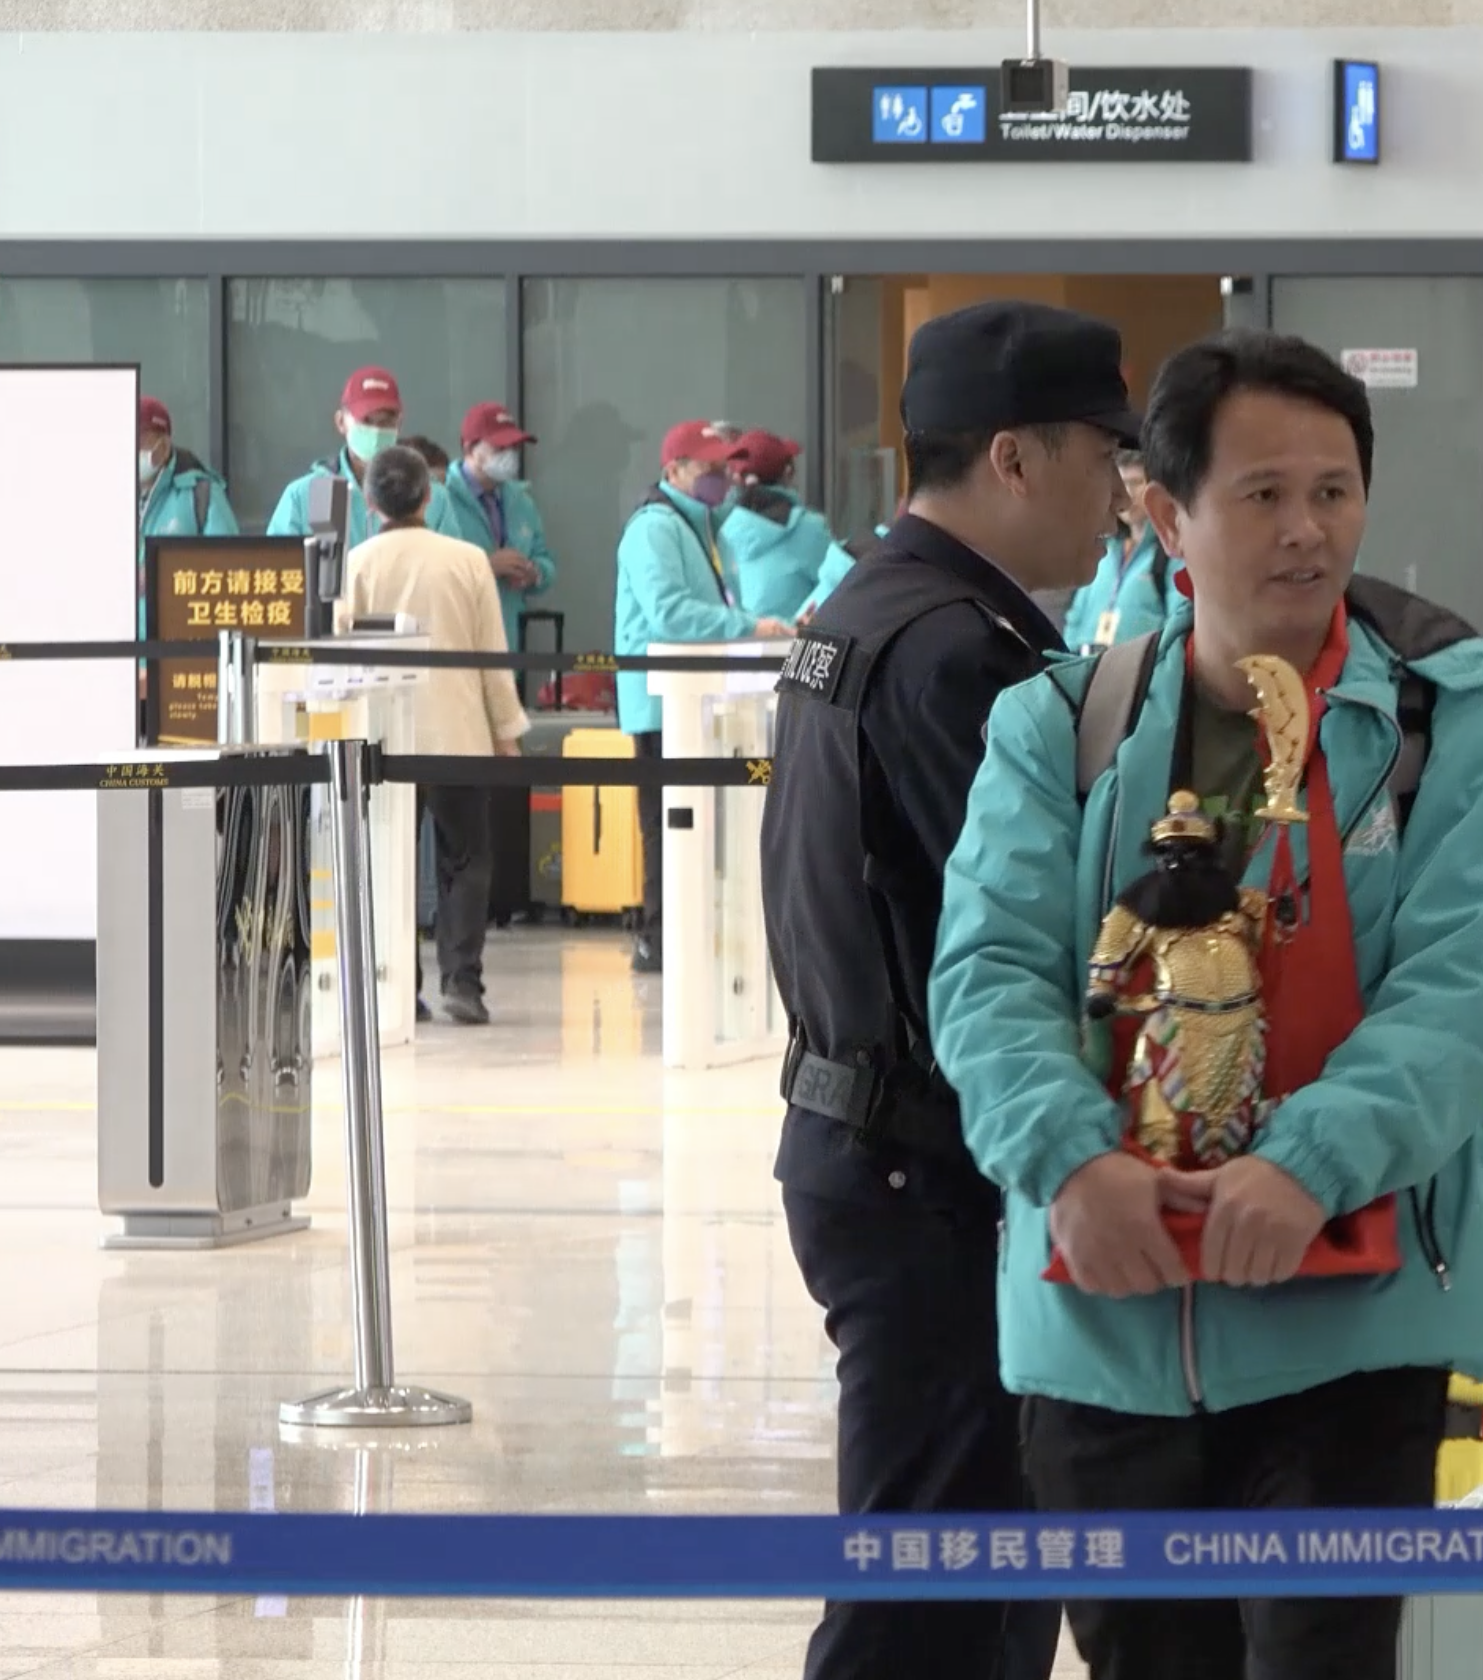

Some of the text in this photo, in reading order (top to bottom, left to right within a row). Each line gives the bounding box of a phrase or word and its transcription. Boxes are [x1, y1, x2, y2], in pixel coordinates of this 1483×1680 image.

[1000, 89, 1191, 122] 间/饮水处
[1000, 123, 1189, 142] Toilet/Water Dispenser
[173, 569, 304, 596] 前方请接受
[187, 600, 292, 626] 卫生检疫
[106, 763, 164, 778] 中国海关
[843, 1530, 1125, 1570] 中国移民管理
[1164, 1532, 1287, 1565] CHINA
